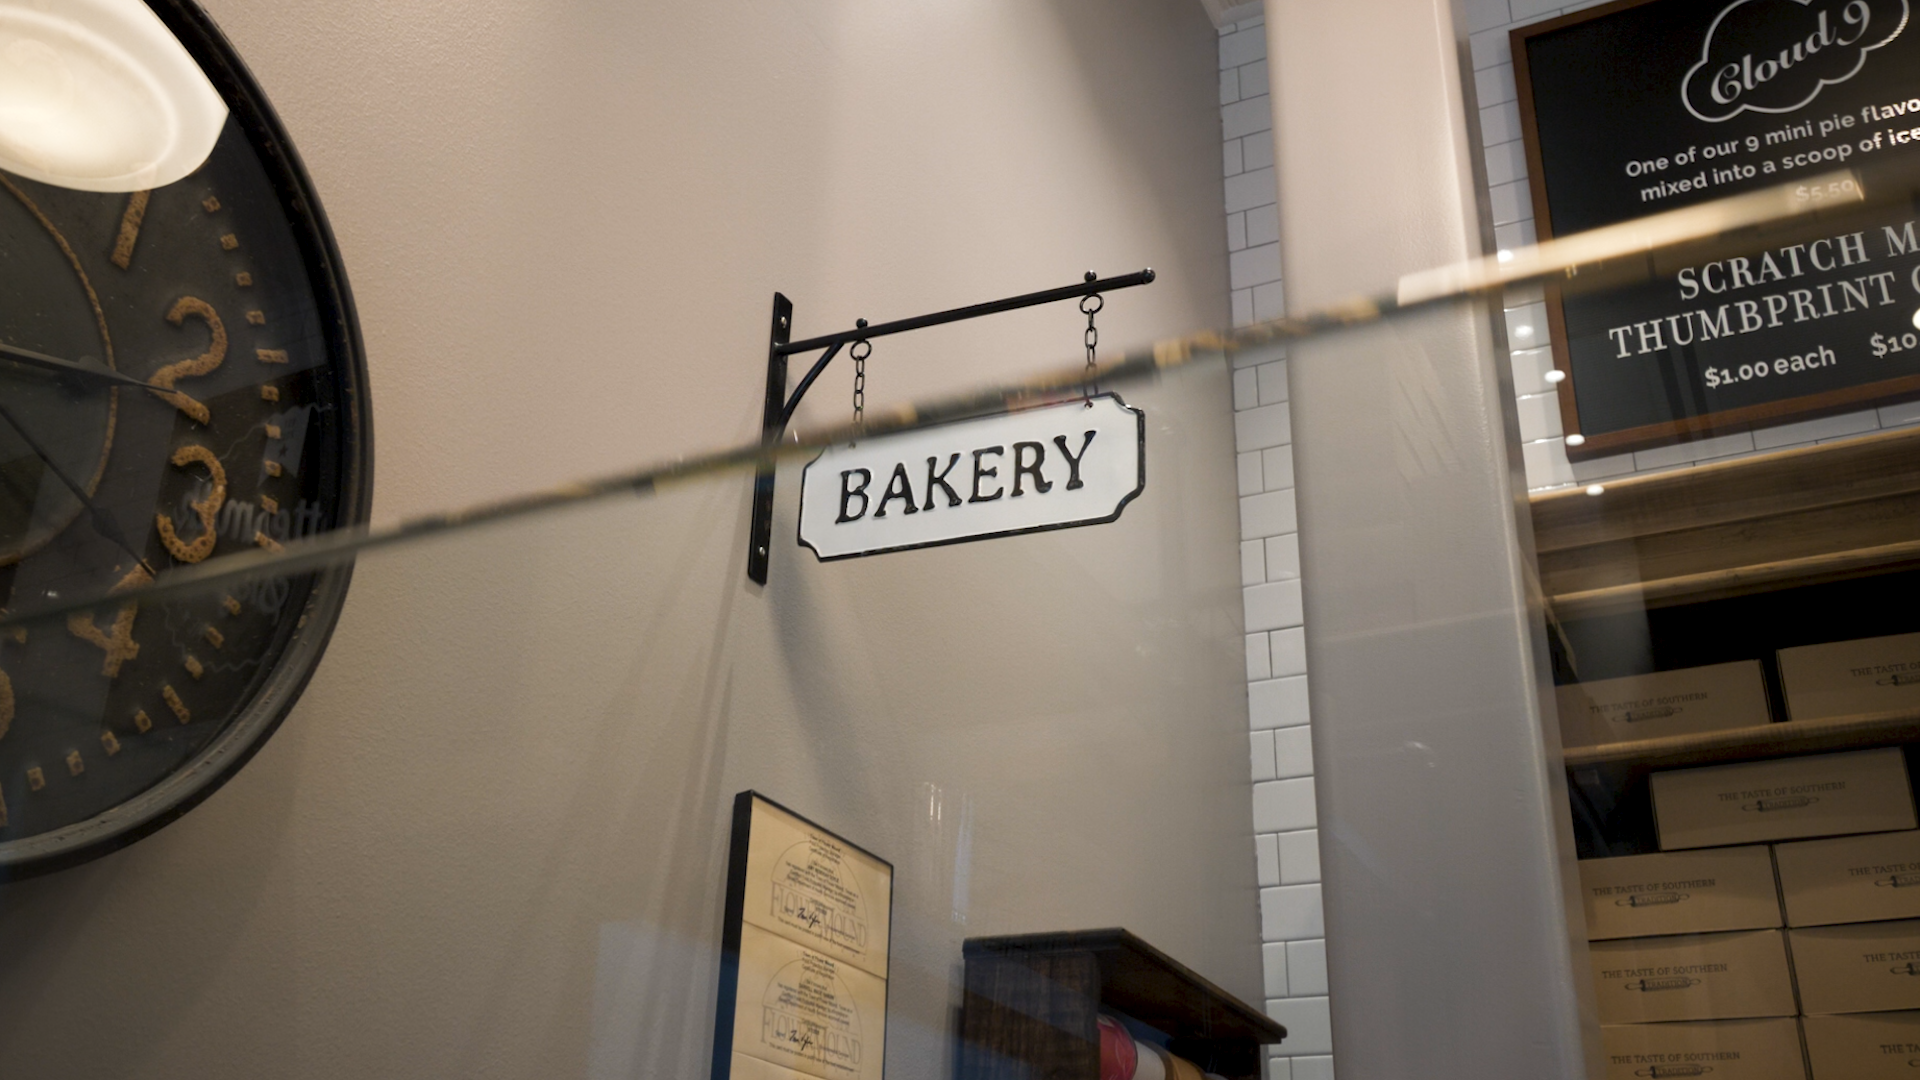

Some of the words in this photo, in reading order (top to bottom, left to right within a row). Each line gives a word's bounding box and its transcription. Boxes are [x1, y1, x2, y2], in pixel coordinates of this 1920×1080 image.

[1711, 10, 1836, 104] Cloud
[1837, 0, 1870, 46] 9
[1625, 156, 1669, 178] One
[1675, 146, 1697, 166] of
[1703, 139, 1739, 160] our
[1745, 135, 1760, 153] 9
[1765, 121, 1814, 146] mini
[1819, 113, 1856, 137] pie
[1640, 172, 1708, 202] mixed
[1713, 163, 1756, 186] into
[1762, 160, 1777, 174] a
[1782, 142, 1853, 169] scoop
[1859, 131, 1882, 152] of
[1887, 126, 1920, 146] ice
[1795, 180, 1854, 202] $5.50
[1677, 231, 1871, 301] SCRATCH
[1609, 271, 1896, 359] THUMBPRINT
[1704, 361, 1769, 389] $1.00
[1774, 345, 1837, 376] each
[835, 430, 1097, 525] BAKERY
[1850, 667, 1872, 677] THE
[1874, 663, 1907, 674] TASTE
[1611, 701, 1640, 711] TASTE
[1642, 698, 1655, 707] OF
[1656, 692, 1708, 704] SOUTHERN
[1718, 792, 1739, 802] THE
[1740, 788, 1773, 800] TASTE
[1774, 787, 1787, 796] OF
[1790, 781, 1846, 795] SOUTHERN
[1848, 867, 1870, 876] THE
[1872, 863, 1907, 874] TASTE
[1592, 887, 1612, 896] THE
[1614, 884, 1644, 894] TASTE
[1646, 882, 1660, 891] OF
[1662, 878, 1716, 890] SOUTHERN
[1863, 953, 1887, 963] THE
[1602, 970, 1622, 979] THE
[1624, 967, 1654, 977] TASTE
[1656, 966, 1670, 975] OF
[1673, 963, 1728, 975] SOUTHERN
[1611, 1055, 1632, 1065] THE
[1634, 1053, 1665, 1063] TASTE
[1668, 1053, 1681, 1062] OF
[1684, 1051, 1740, 1062] SOUTHERN
[1879, 1044, 1905, 1054] THE
